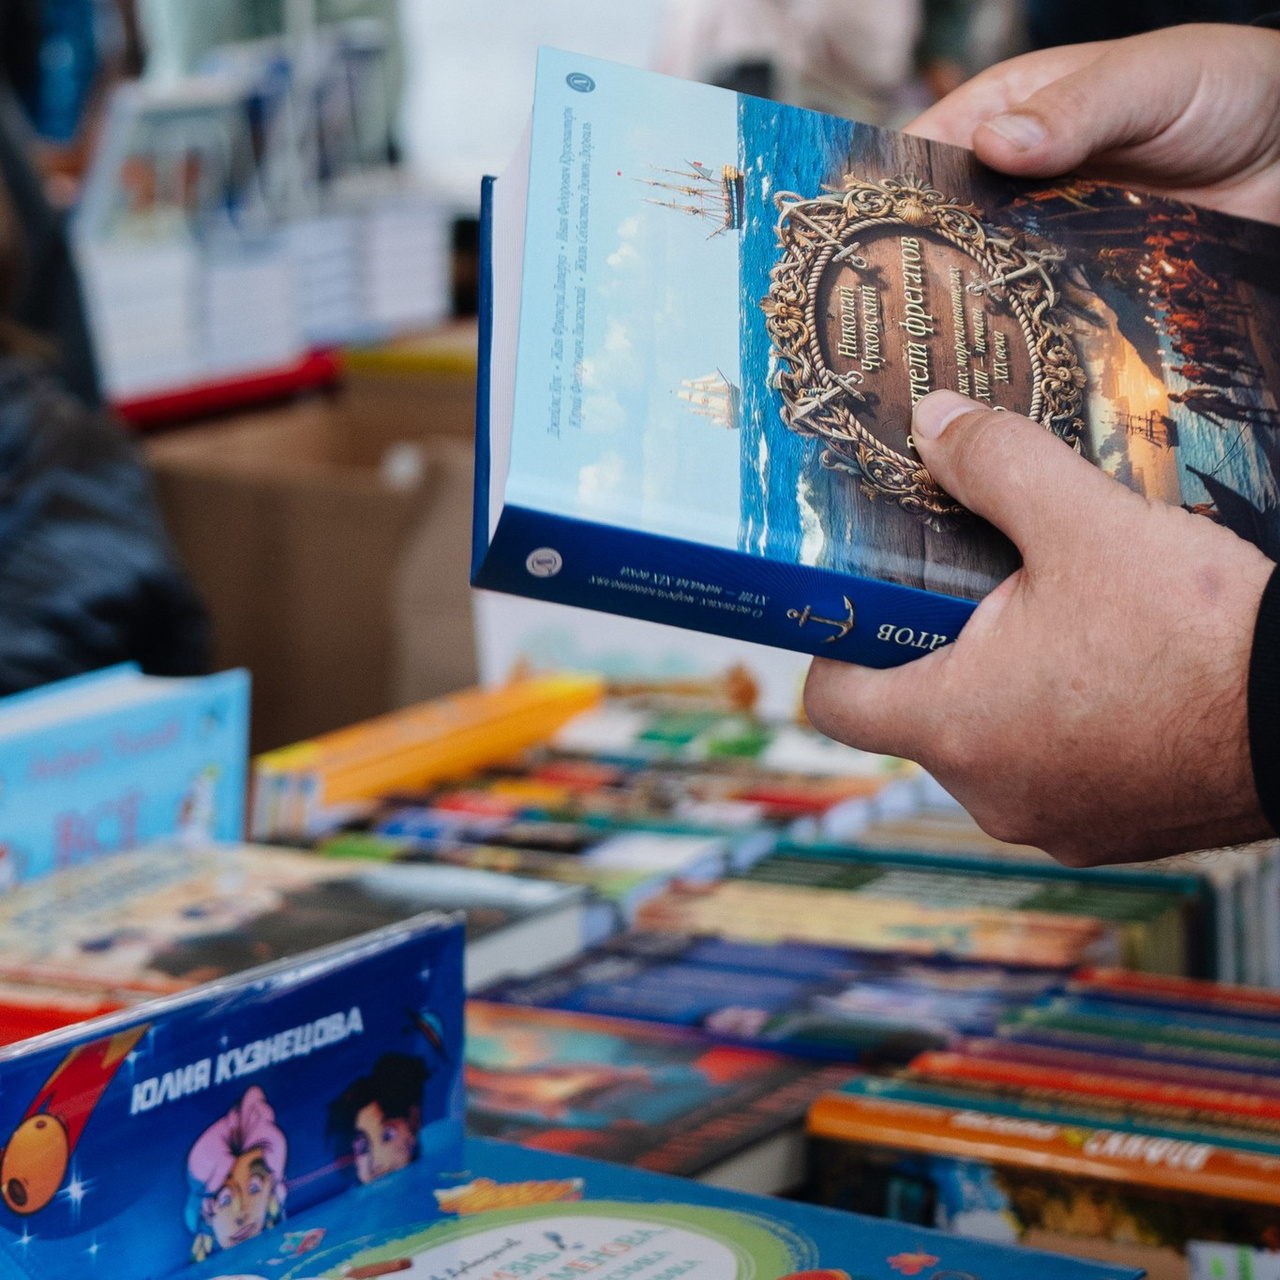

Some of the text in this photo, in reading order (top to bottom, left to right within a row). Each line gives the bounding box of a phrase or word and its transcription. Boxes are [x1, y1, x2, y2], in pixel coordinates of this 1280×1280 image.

[837, 284, 858, 359] Николай
[858, 285, 880, 371] Чуковский
[899, 236, 934, 449] ители фрегатов
[948, 264, 972, 370] мореплавателях
[971, 307, 986, 353] начала
[974, 368, 991, 402] XVIII
[993, 330, 1010, 384] XIX века
[877, 624, 947, 651] атов
[131, 1006, 364, 1115] ЮЛИЯ КУЗНЕЦОВА
